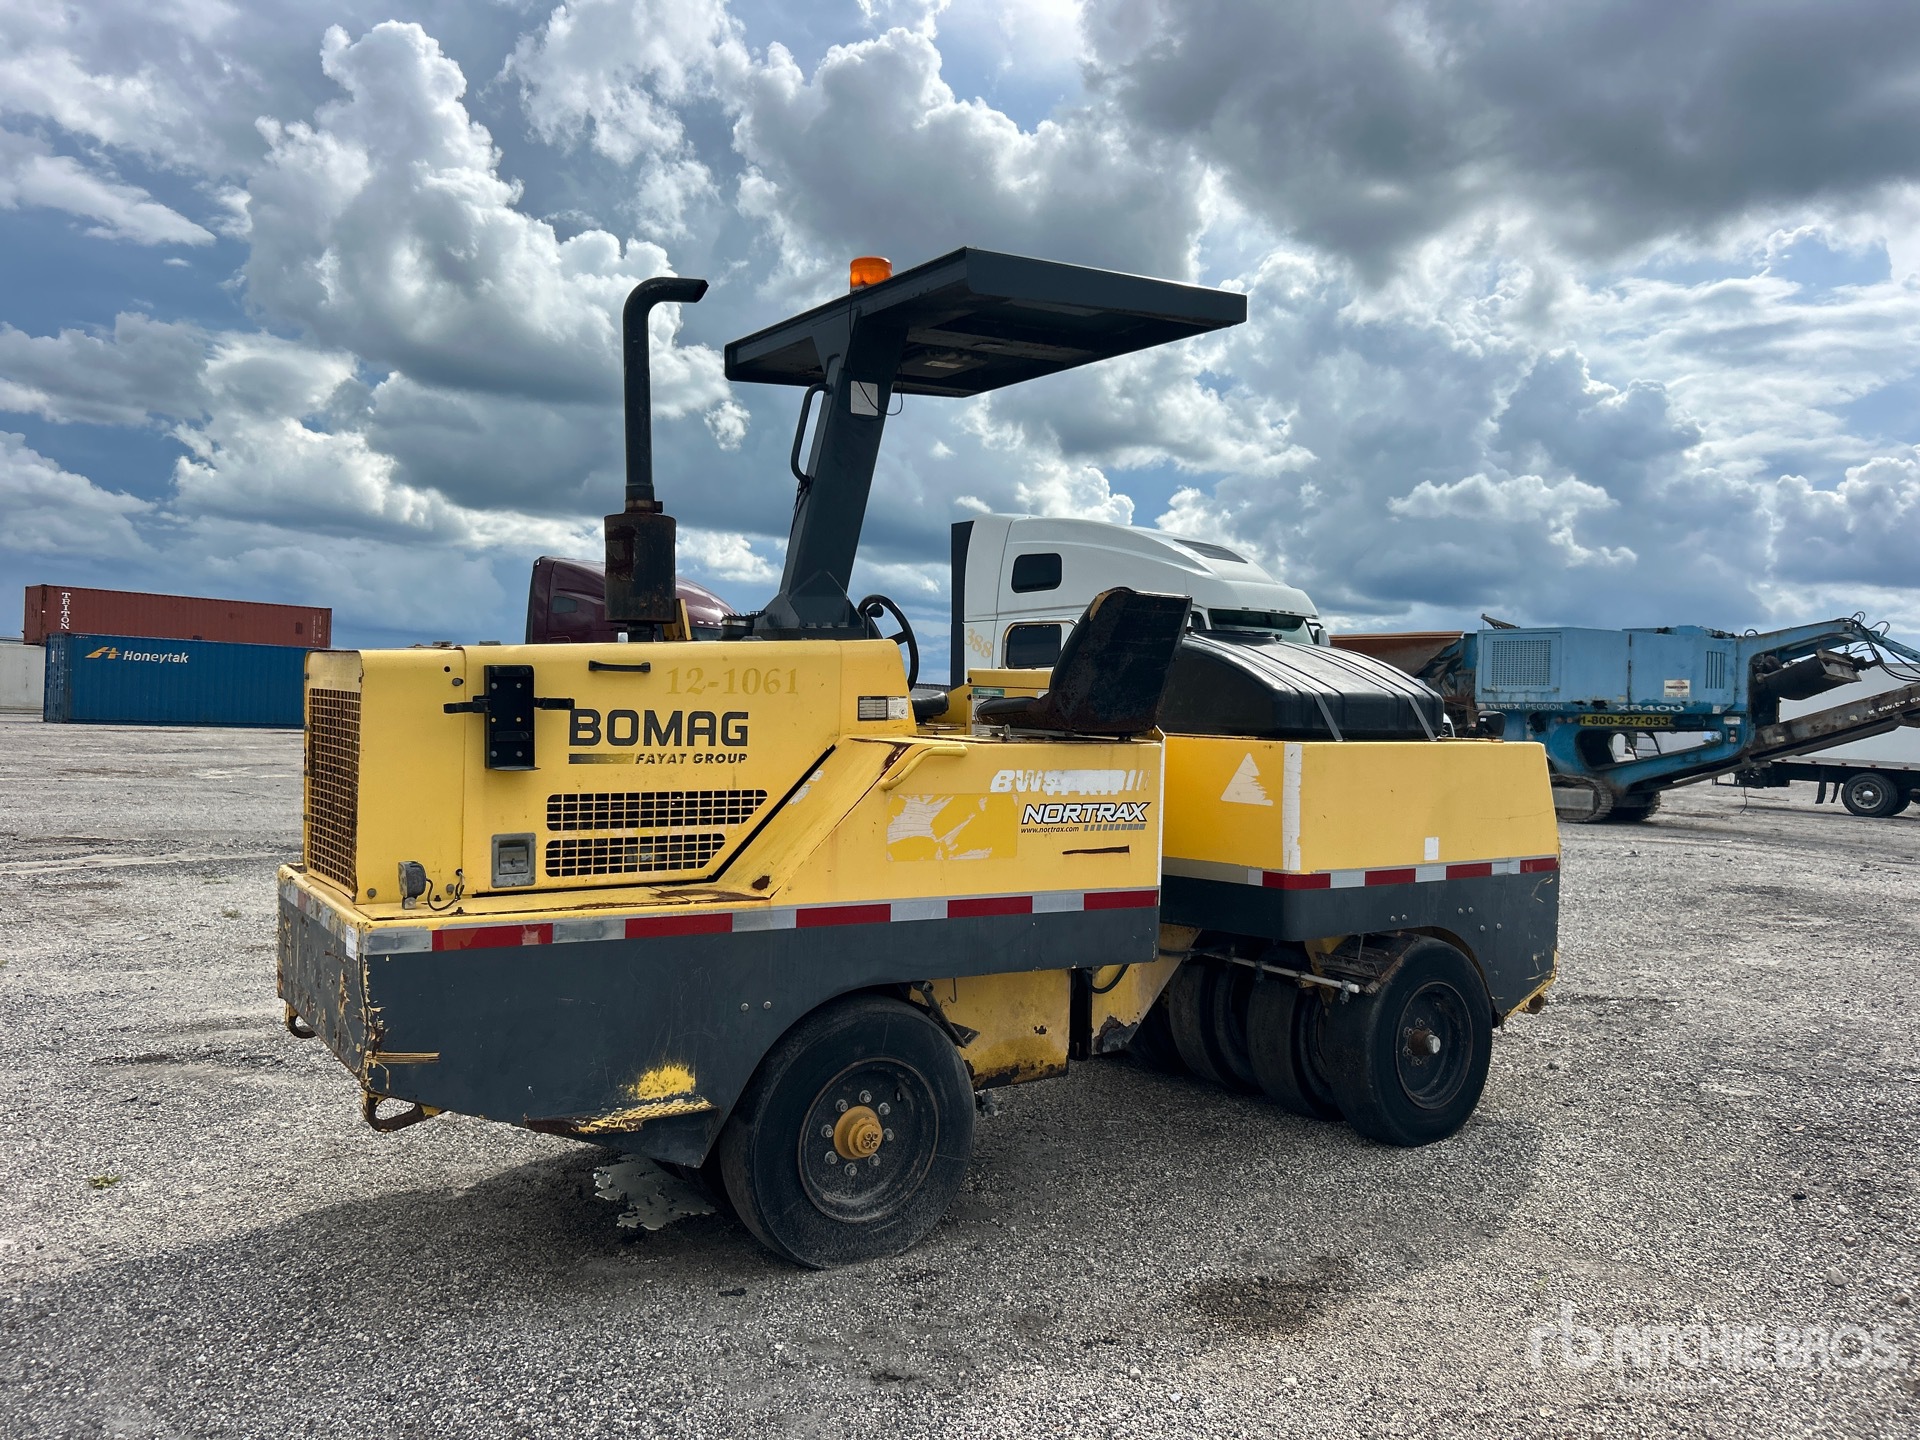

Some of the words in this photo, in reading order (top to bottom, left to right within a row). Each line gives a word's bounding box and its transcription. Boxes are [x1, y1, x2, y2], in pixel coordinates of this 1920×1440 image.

[61, 592, 71, 630] TRITON
[965, 627, 993, 658] 388
[123, 650, 189, 664] Honeytak
[665, 667, 799, 695] 12-1061
[1525, 703, 1564, 711] PEGSON
[1616, 704, 1685, 712] XR400
[569, 708, 749, 747] BOMAG
[1580, 715, 1672, 727] 1-800-227-053
[635, 753, 688, 765] FAYAT
[692, 752, 748, 764] GROUP
[1021, 802, 1152, 825] NORTRAX
[1020, 825, 1080, 835] www.nortrax.com
